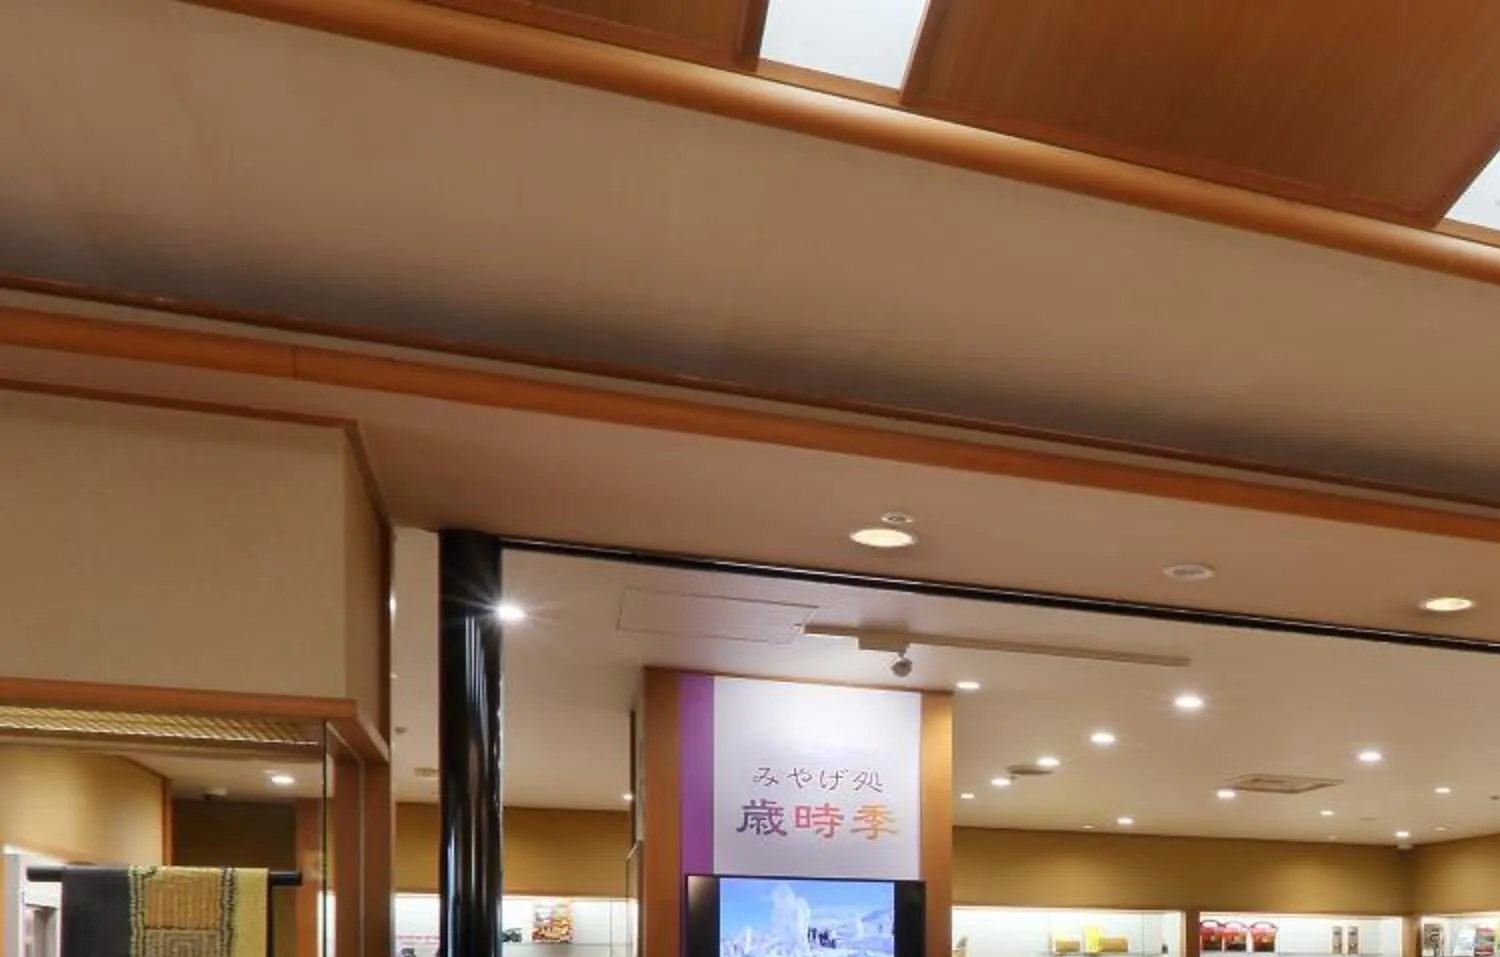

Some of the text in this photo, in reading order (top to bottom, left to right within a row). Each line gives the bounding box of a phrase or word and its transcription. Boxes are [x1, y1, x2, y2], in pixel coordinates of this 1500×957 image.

[753, 766, 884, 793] みやげ処
[736, 799, 898, 840] 歳時季
